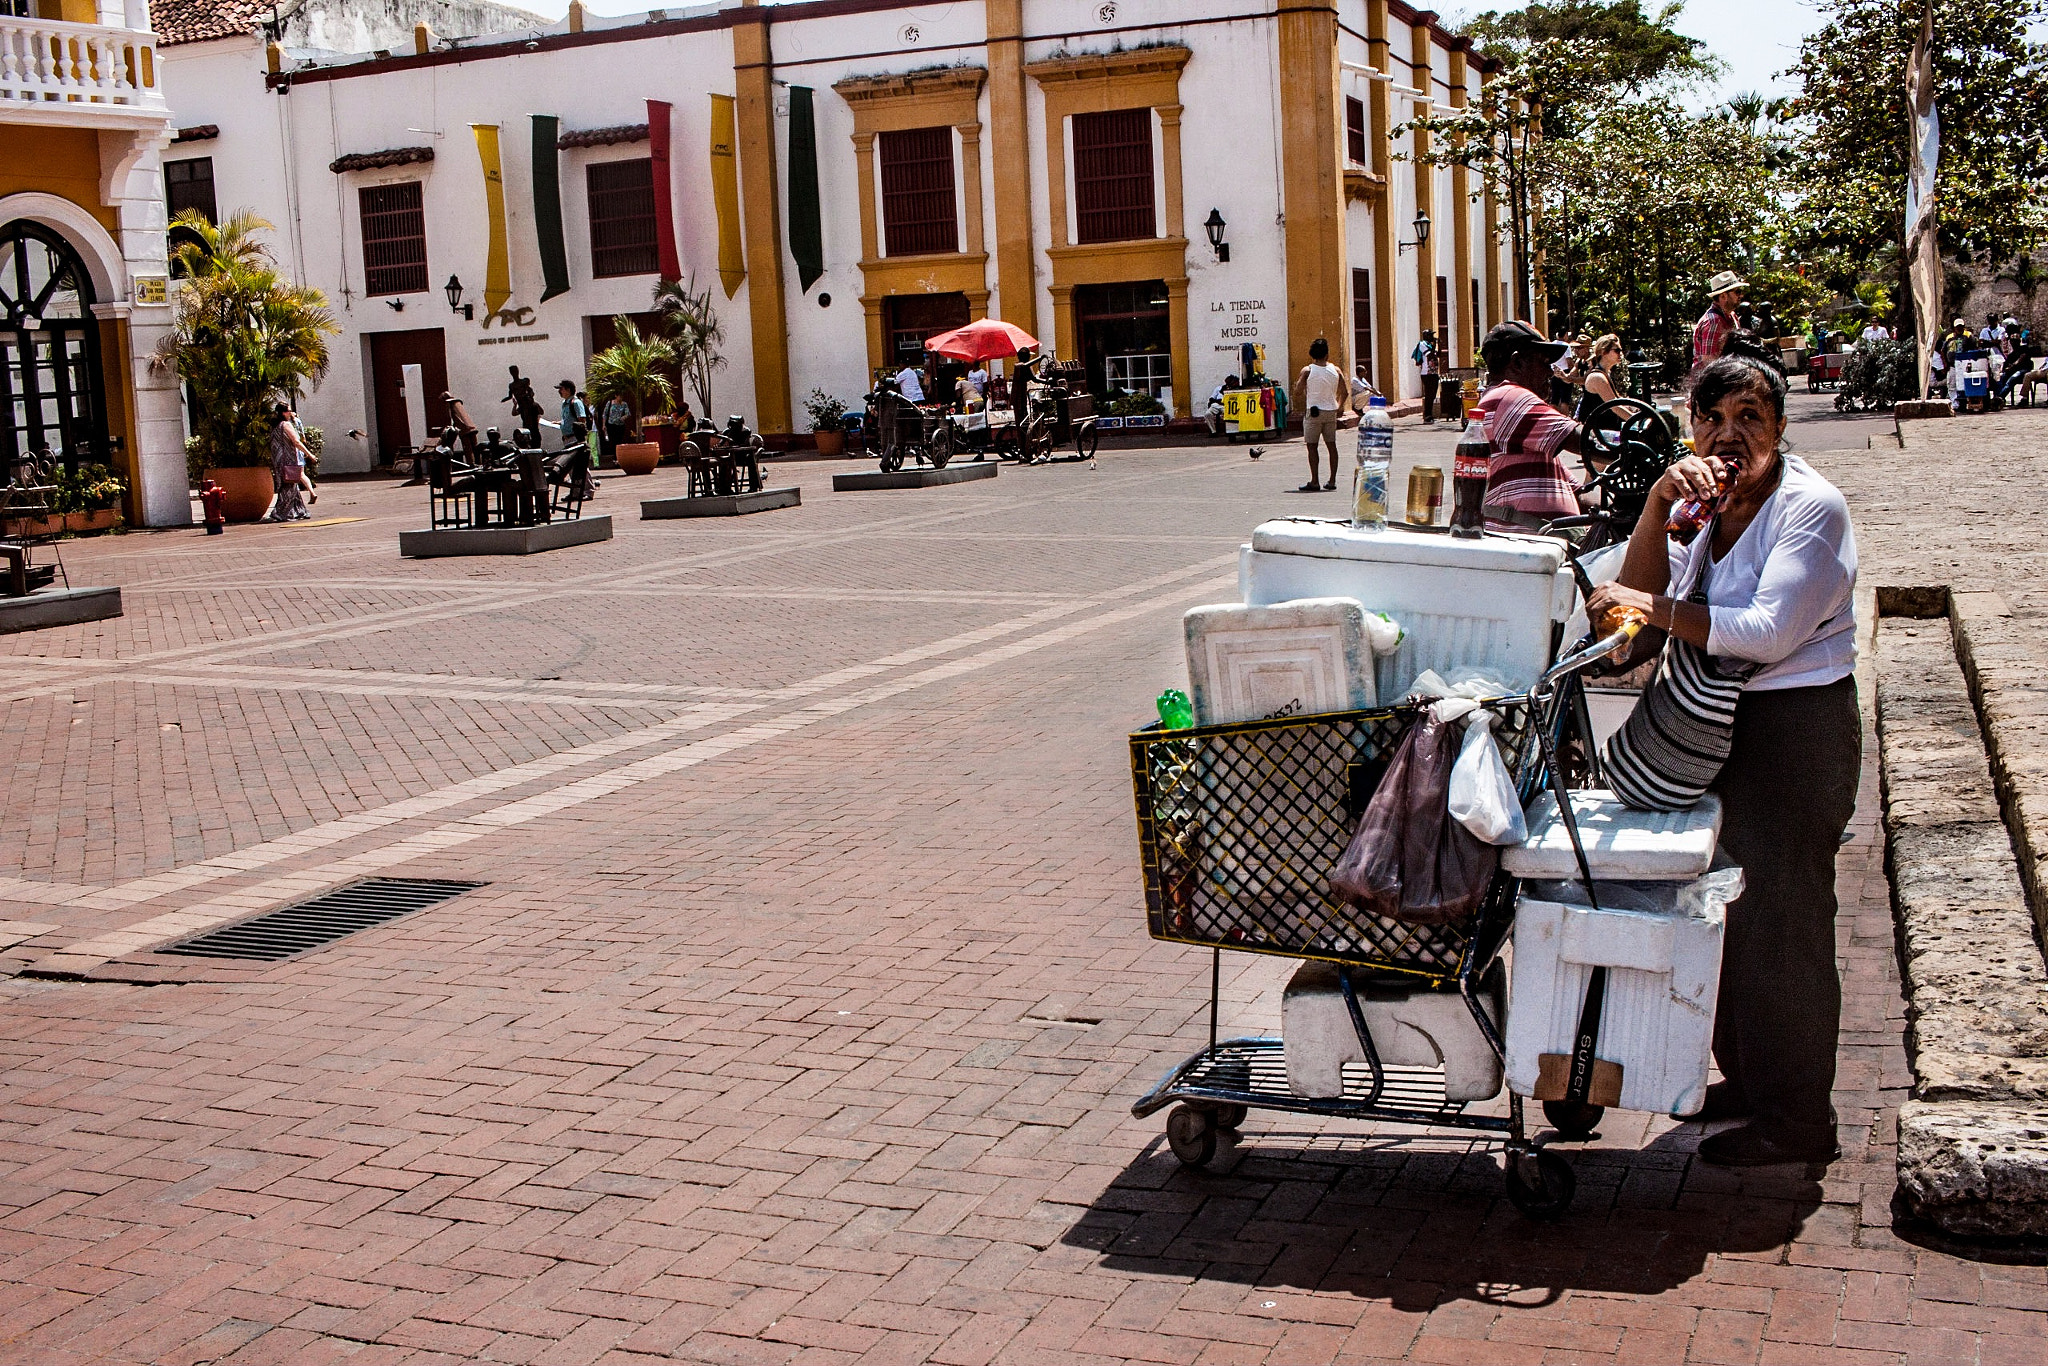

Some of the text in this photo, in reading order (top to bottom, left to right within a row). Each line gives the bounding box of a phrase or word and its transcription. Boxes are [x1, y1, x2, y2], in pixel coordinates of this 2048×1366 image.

[1211, 300, 1266, 312] LA TIENDA
[1236, 314, 1258, 324] DEL
[1221, 327, 1258, 338] MUSEO
[1228, 401, 1238, 415] 10
[1246, 399, 1256, 414] 10
